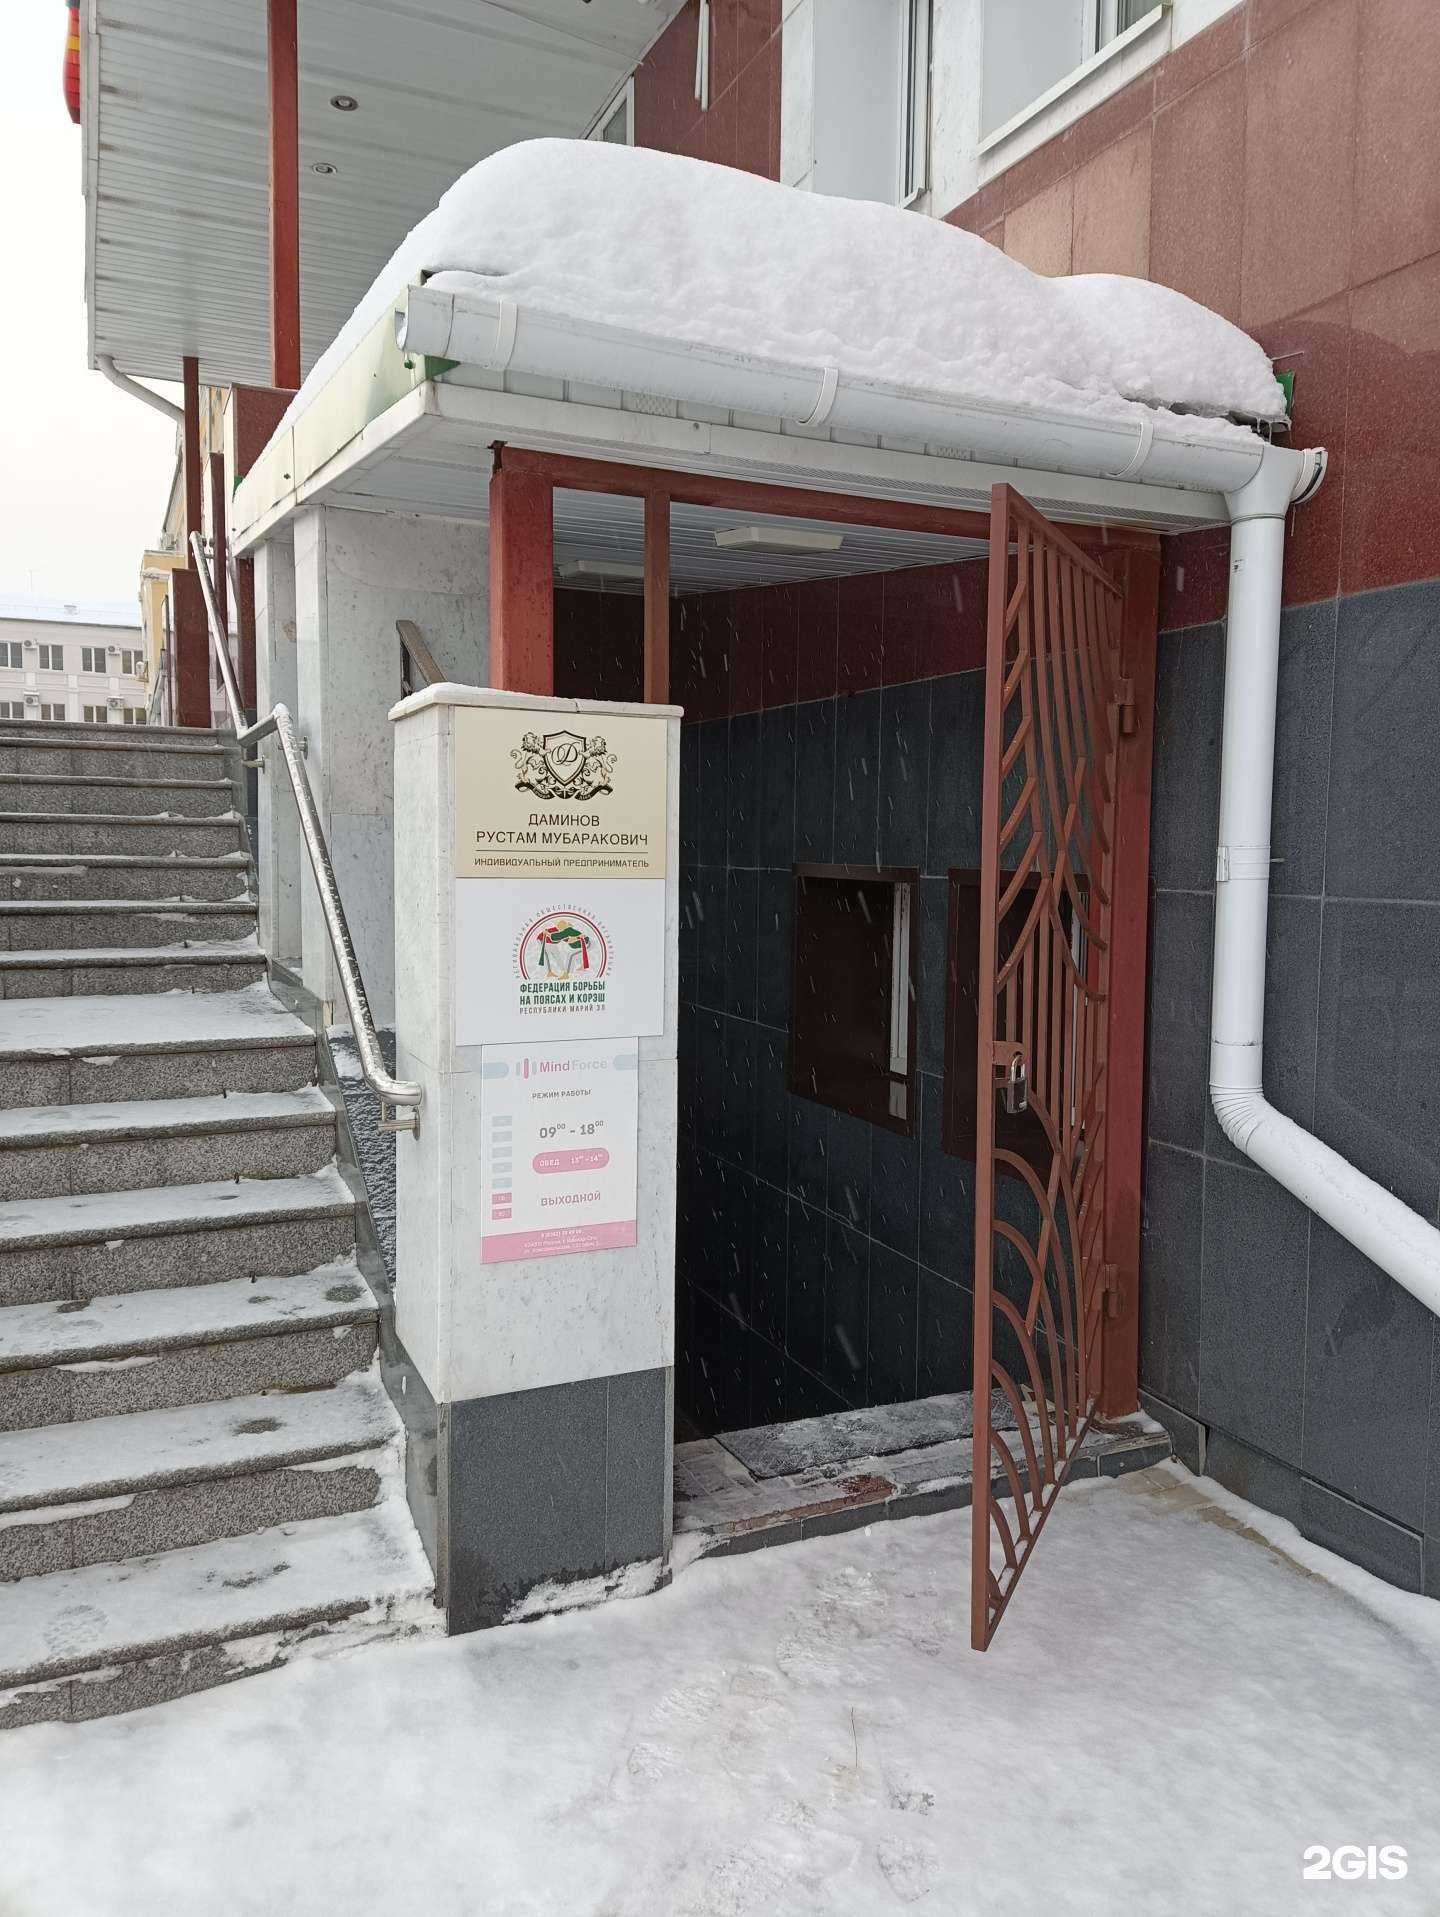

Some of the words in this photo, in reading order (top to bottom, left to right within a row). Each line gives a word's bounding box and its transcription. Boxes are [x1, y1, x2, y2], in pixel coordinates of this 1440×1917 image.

[528, 813, 600, 827] ДАМИНОВ
[476, 831, 537, 844] РУСТАМ
[542, 832, 648, 845] МУБАРАКОВИЧ
[474, 858, 561, 867] ИНДИВИДУАЛЬНЫЙ
[564, 859, 649, 868] ПРЕДПРИНИМАТЕЛЬ
[520, 983, 571, 994] ФЕДЕРАЦИЯ
[573, 981, 605, 991] БОРЬБЫ
[520, 995, 531, 1005] НА
[533, 994, 566, 1005] ПОЯСАХ
[569, 994, 575, 1003] И
[577, 993, 605, 1003] КОРЭШ
[520, 1006, 567, 1015] РЕСПУБЛИКИ
[532, 1091, 559, 1099] РЕЖИМ
[561, 1089, 592, 1098] РАБОТЫ
[541, 1190, 601, 1206] ВЫХОДНОЙ
